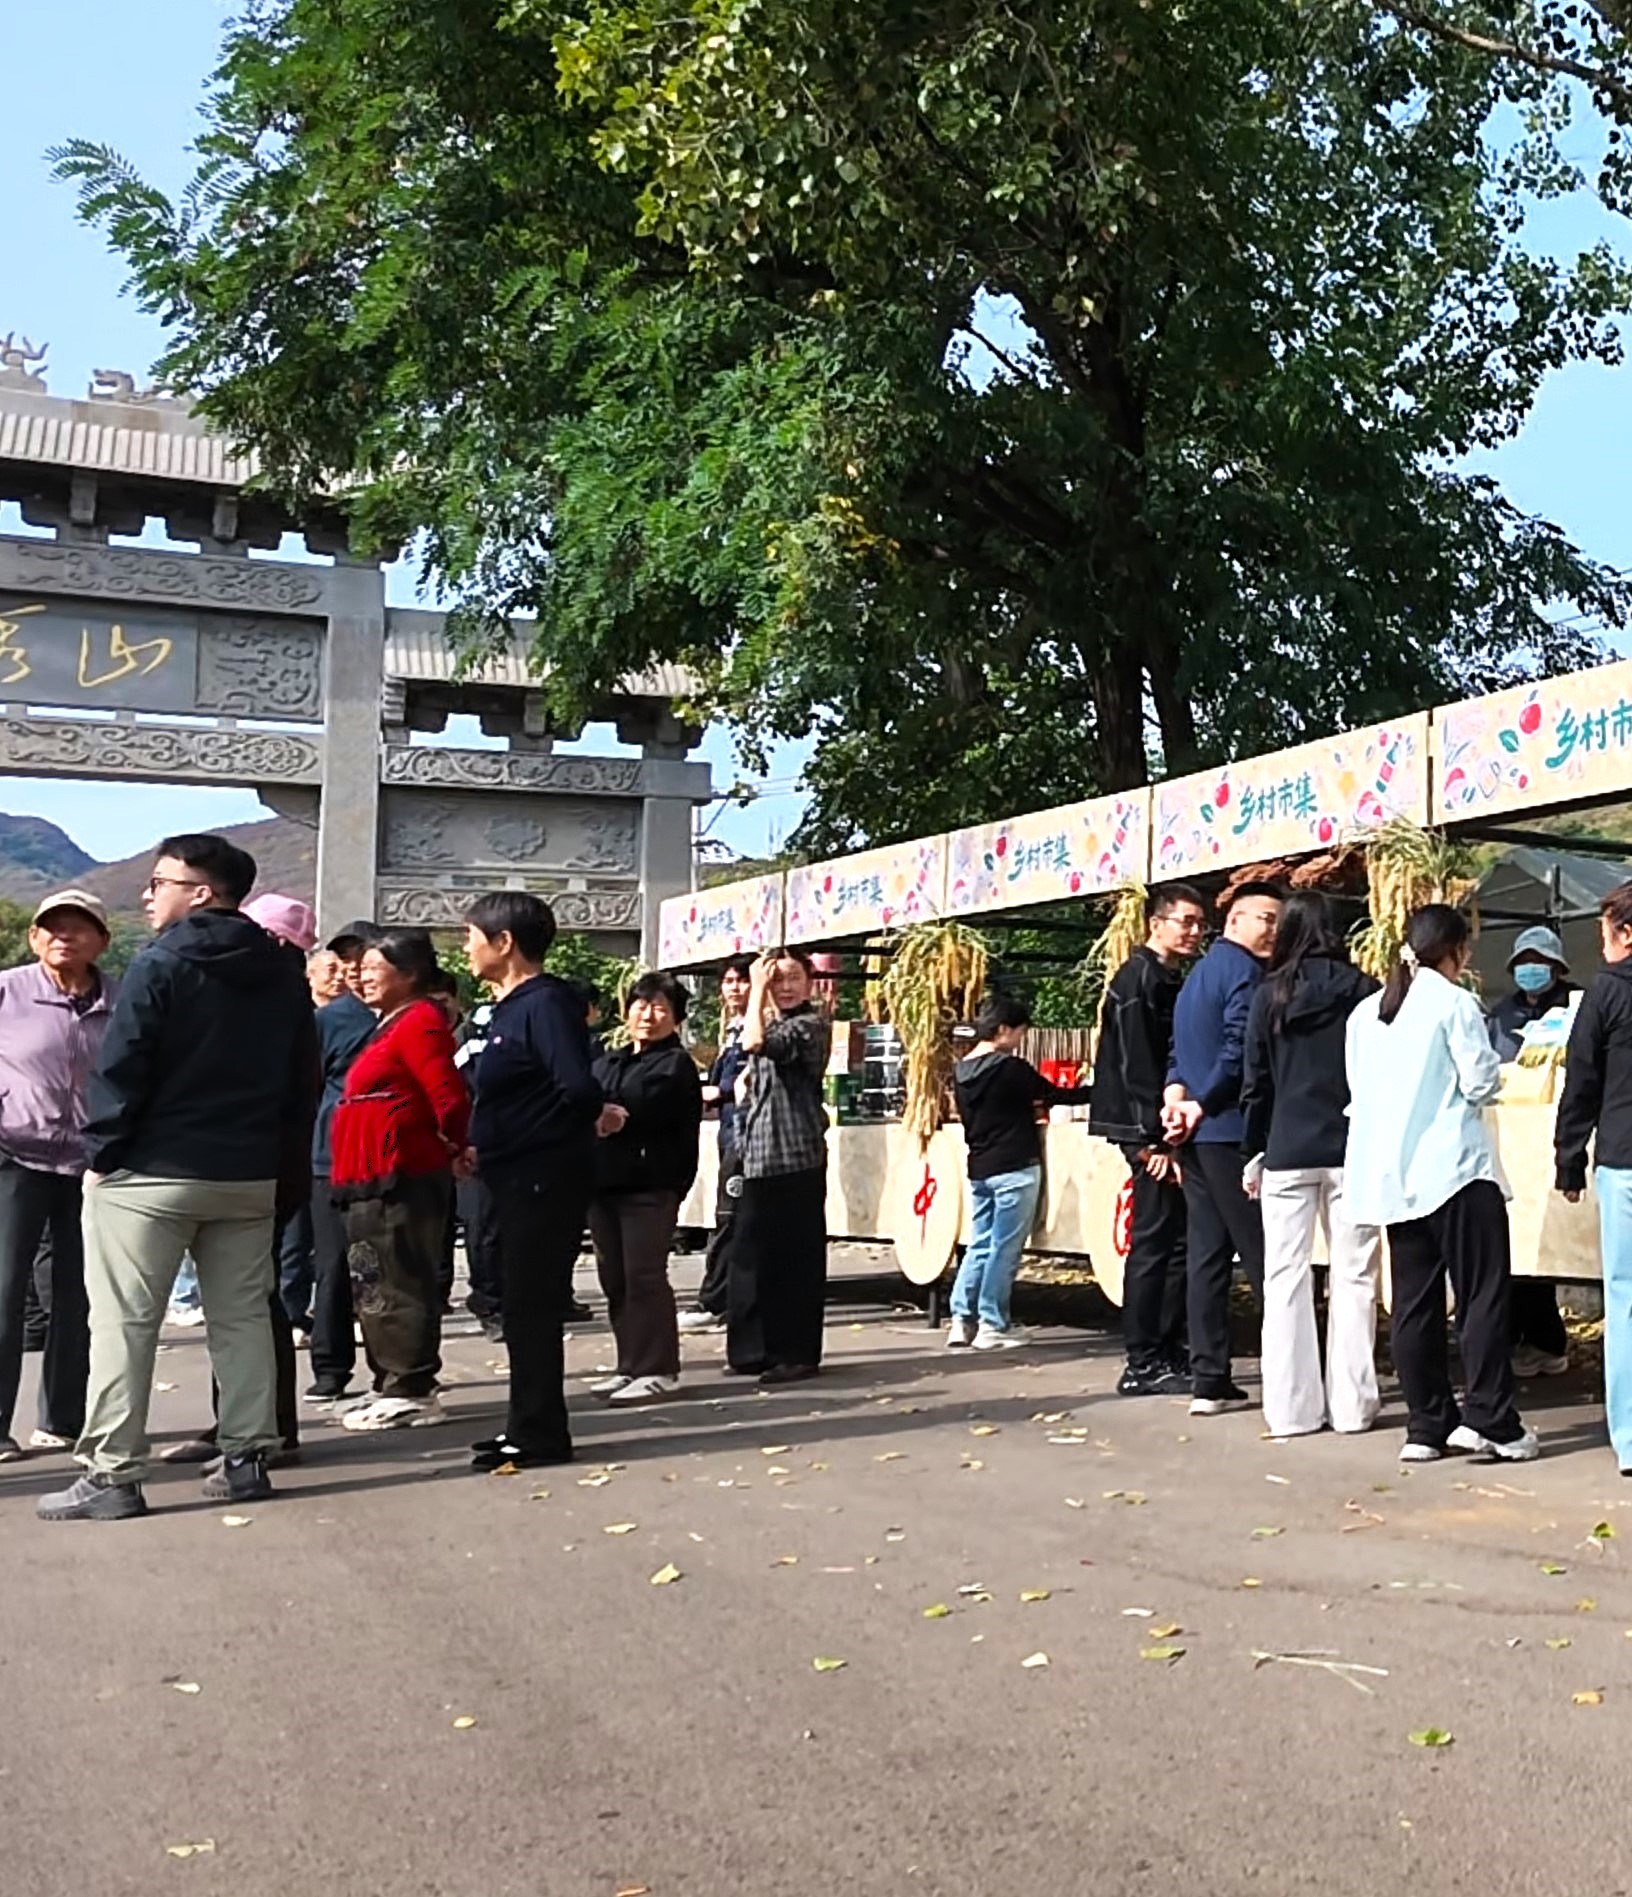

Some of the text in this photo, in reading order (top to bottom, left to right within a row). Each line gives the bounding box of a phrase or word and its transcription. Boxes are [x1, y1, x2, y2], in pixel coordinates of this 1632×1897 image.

[1232, 771, 1318, 835] 乡村市集
[1007, 832, 1071, 882] 乡村市集
[833, 875, 883, 916] 乡村市集
